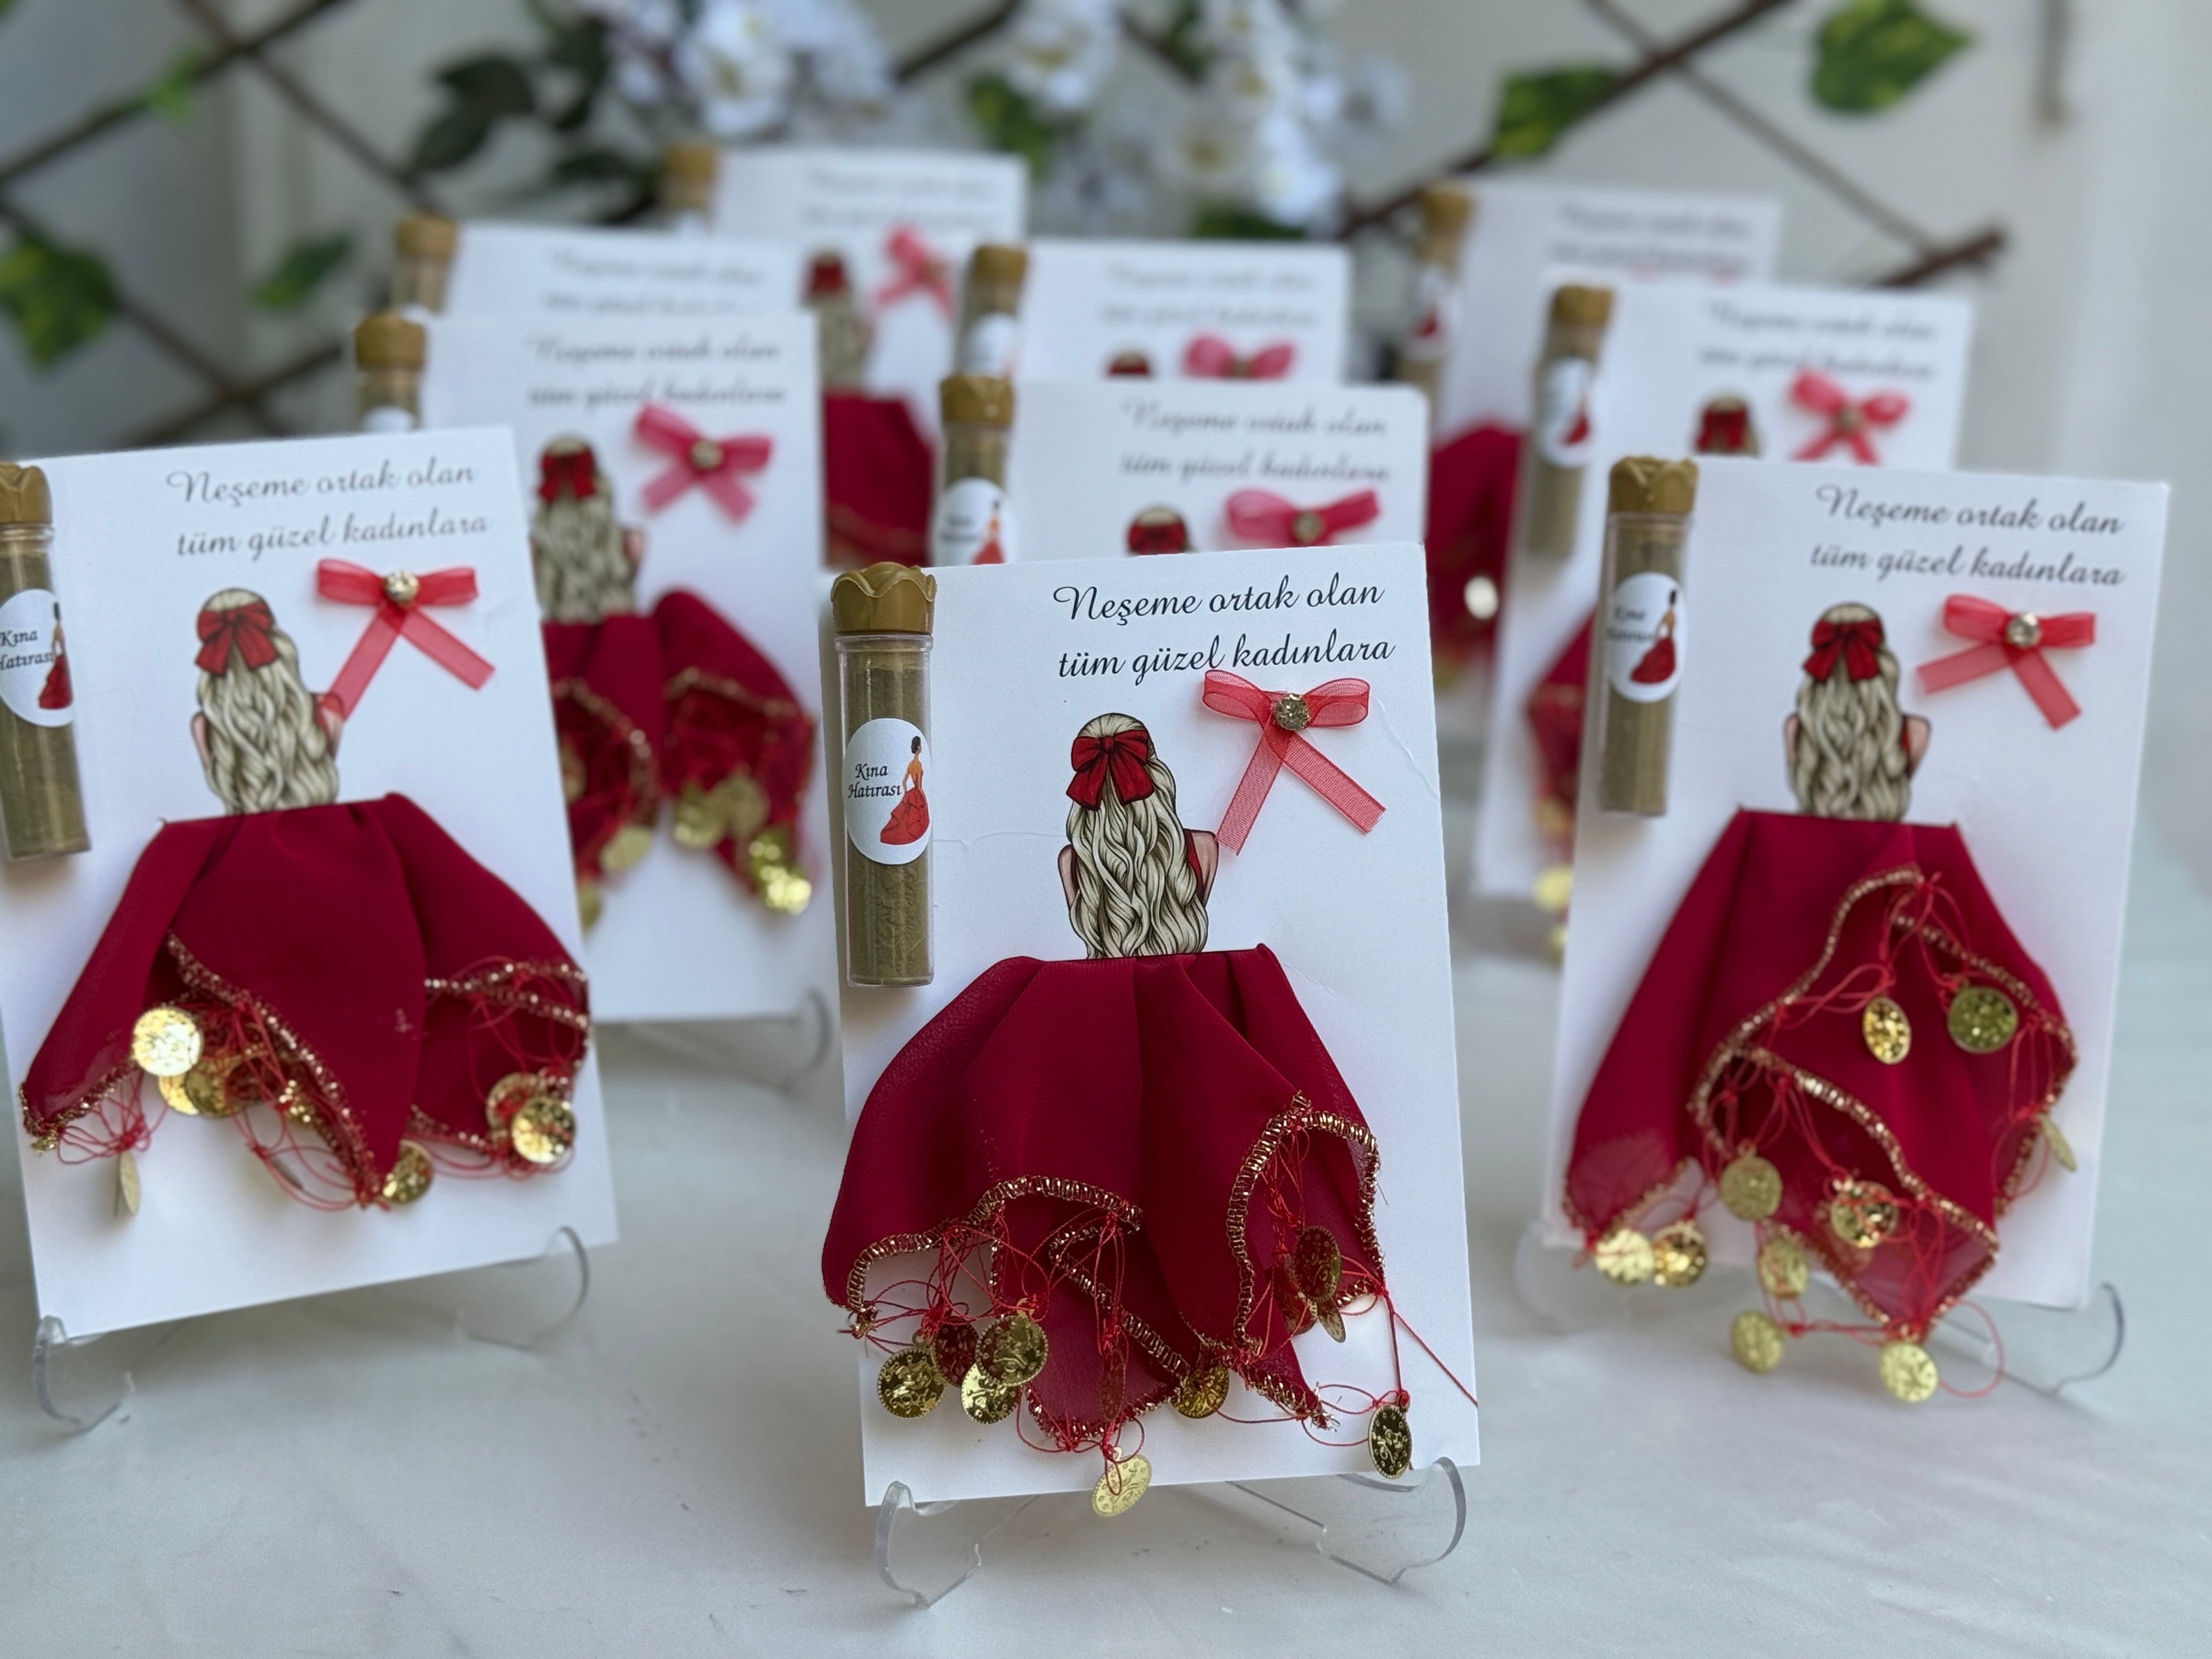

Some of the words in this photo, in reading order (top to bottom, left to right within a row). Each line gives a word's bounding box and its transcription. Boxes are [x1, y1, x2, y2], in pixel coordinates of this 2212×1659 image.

[166, 470, 309, 506] Neşeme
[316, 459, 399, 493] ortak
[406, 456, 477, 488] olan
[1816, 484, 1950, 527] Neşeme
[1956, 498, 2043, 529] ortak
[2048, 502, 2126, 535] olan
[176, 532, 241, 556] tüm
[247, 514, 335, 562] güzel
[343, 508, 493, 543] kadınlara
[1810, 544, 1870, 567] tüm
[1877, 545, 1965, 582] güzel
[1970, 546, 2127, 585] kadınlara
[1053, 586, 1203, 626] Neşeme
[1209, 574, 1301, 613] ortak
[1306, 572, 1385, 607] olan
[0, 630, 38, 647] Kına
[1059, 649, 1127, 677] tüm
[1131, 635, 1226, 686] güzel
[1232, 628, 1396, 668] kadınlara
[847, 781, 902, 798] Hatırası
[855, 763, 889, 781] Kına
